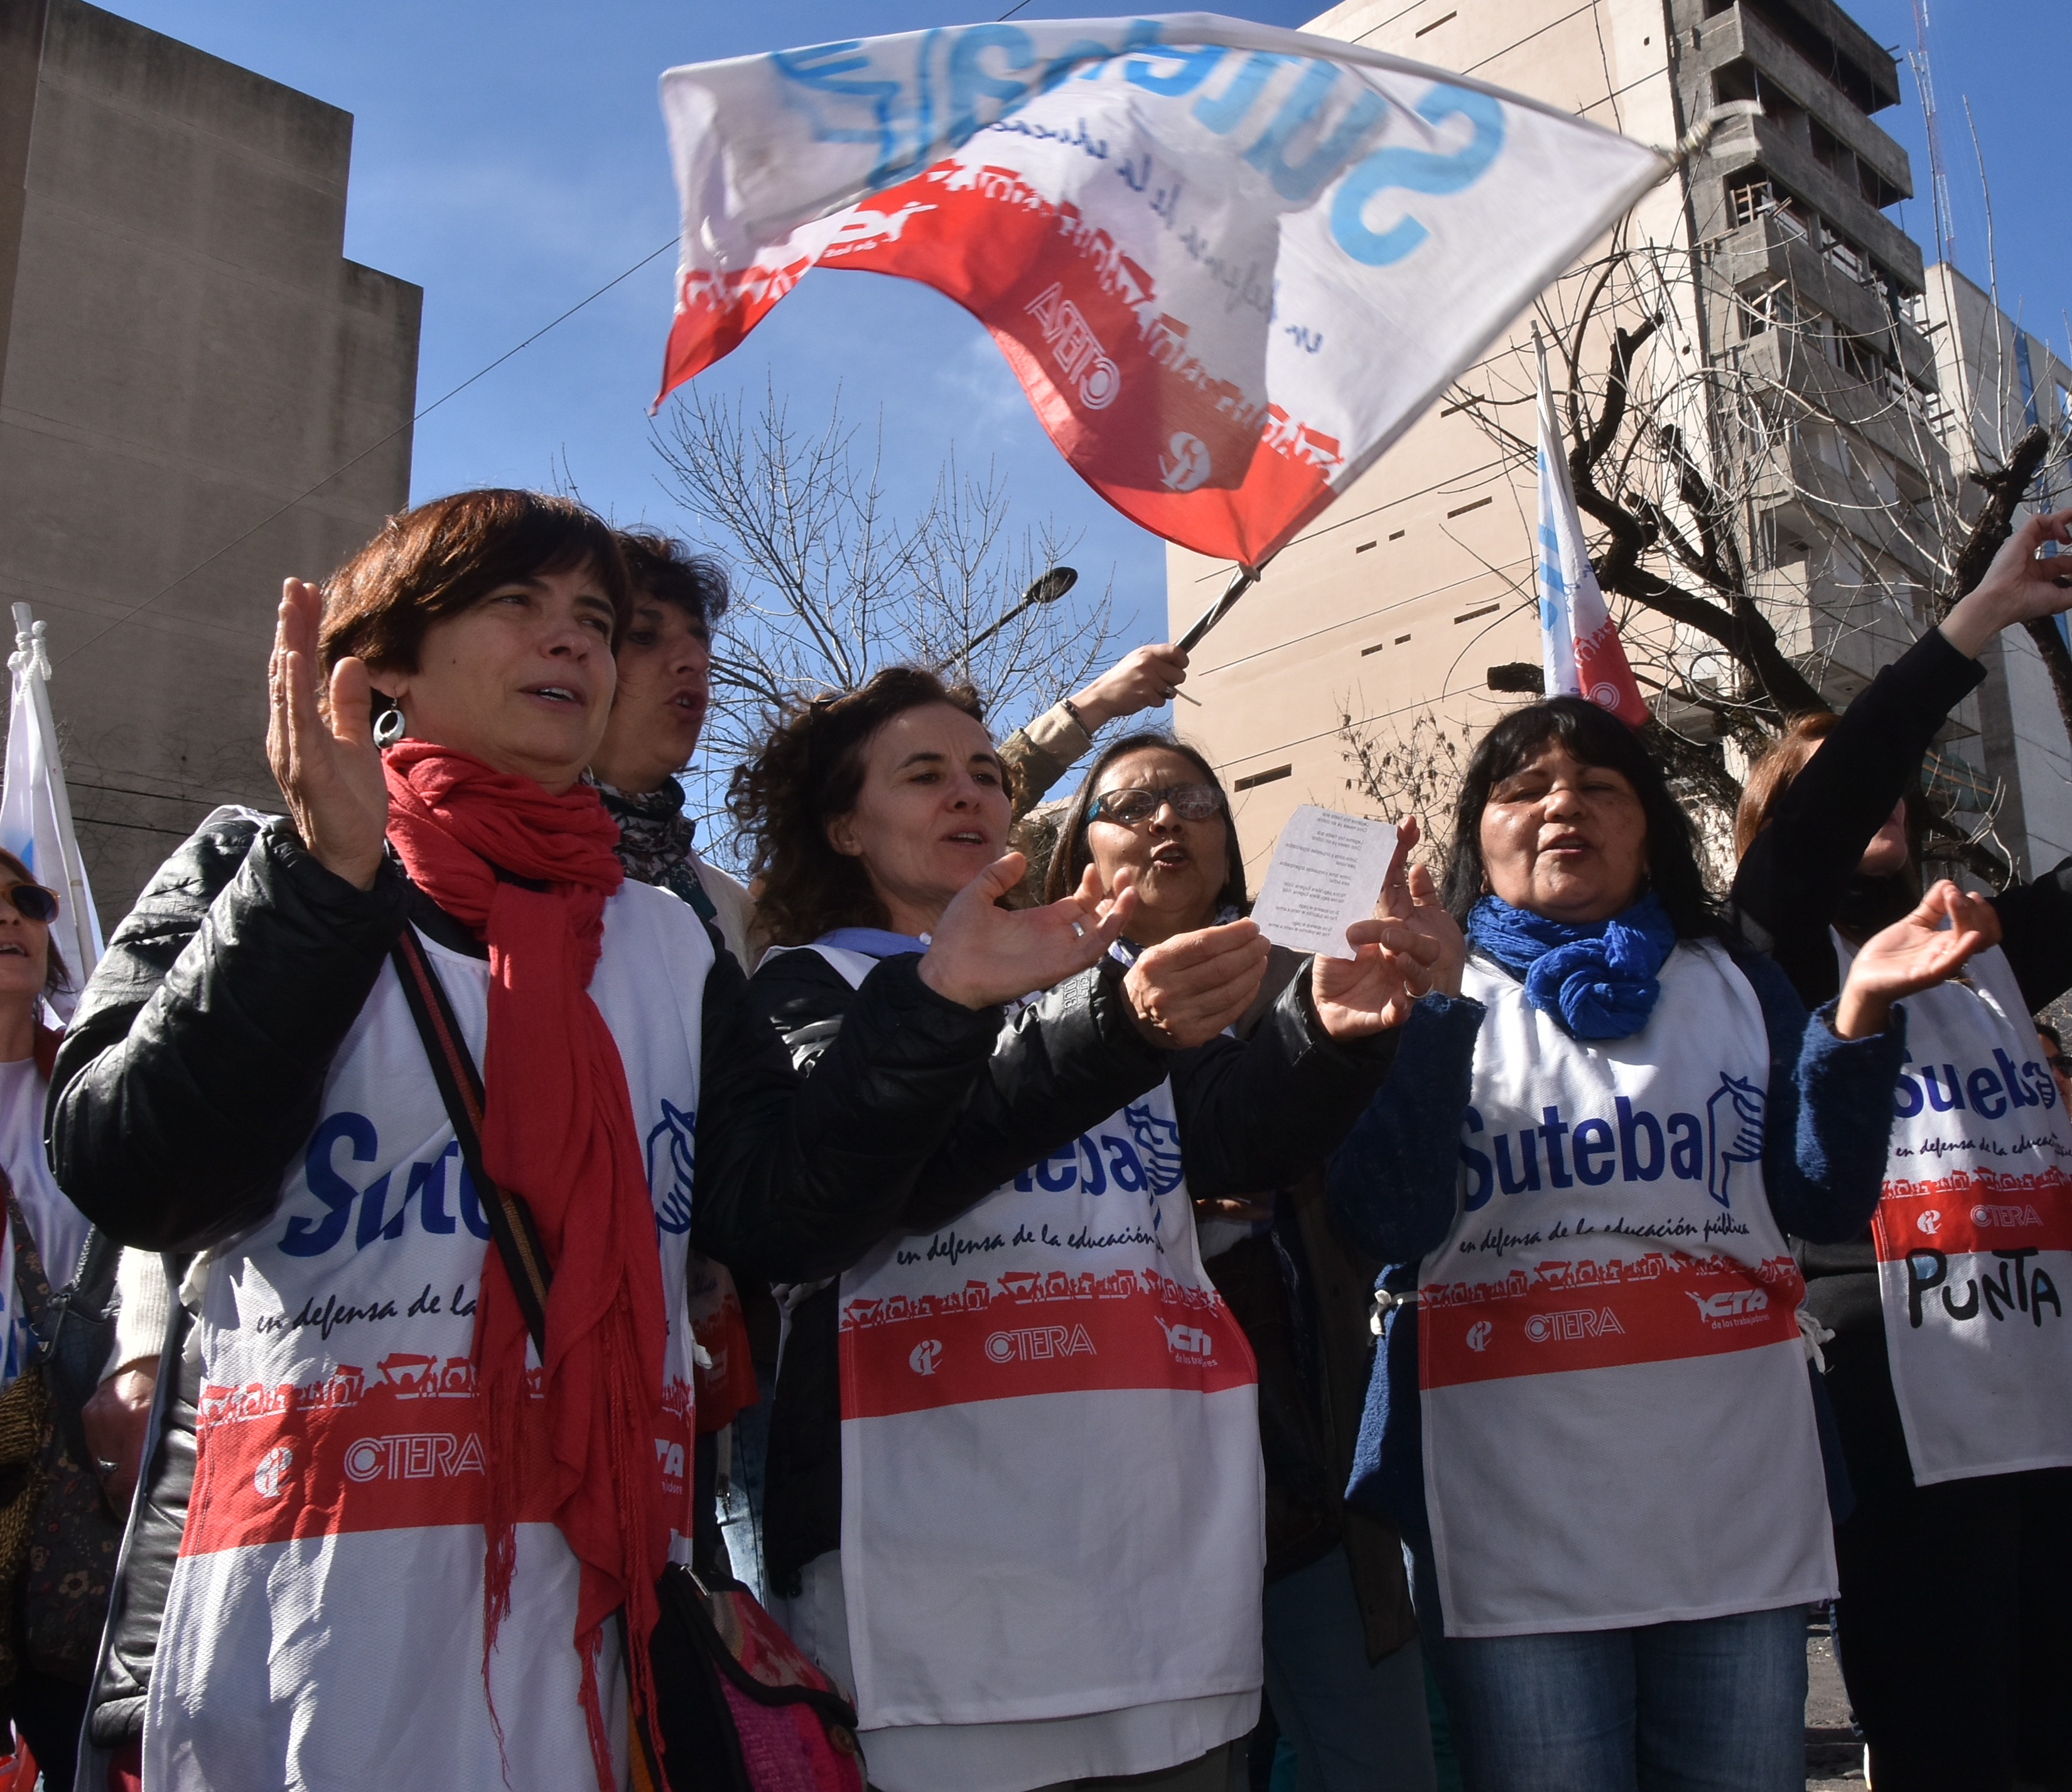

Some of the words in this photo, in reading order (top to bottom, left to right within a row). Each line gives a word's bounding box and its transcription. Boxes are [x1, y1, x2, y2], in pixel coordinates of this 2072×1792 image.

[1460, 1096, 1703, 1212] Suteba
[1896, 1147, 1914, 1157] en
[1920, 1137, 1977, 1158] defensa
[1979, 1137, 1991, 1153] de
[1993, 1141, 2008, 1156] la
[1460, 1241, 1476, 1253] en
[1480, 1228, 1541, 1256] defensa
[1548, 1221, 1568, 1240] de
[1604, 1217, 1698, 1238] educación
[1703, 1212, 1749, 1242] pública
[1970, 1204, 2043, 1228] CTERA
[897, 1250, 920, 1265] en
[927, 1232, 1005, 1266] defensa
[1013, 1224, 1035, 1246] de
[1042, 1224, 1061, 1247] la
[1067, 1226, 1155, 1250] educación
[1708, 1287, 1768, 1317] CTA
[1906, 1247, 2062, 1329] PUNTA
[257, 1315, 283, 1334] en
[292, 1294, 397, 1341] defensa
[408, 1283, 441, 1317] de
[1524, 1307, 1625, 1342] CTERA
[1712, 1320, 1722, 1329] de
[1723, 1319, 1733, 1327] los
[985, 1324, 1097, 1363] CTERA
[344, 1432, 486, 1482] CTERA
